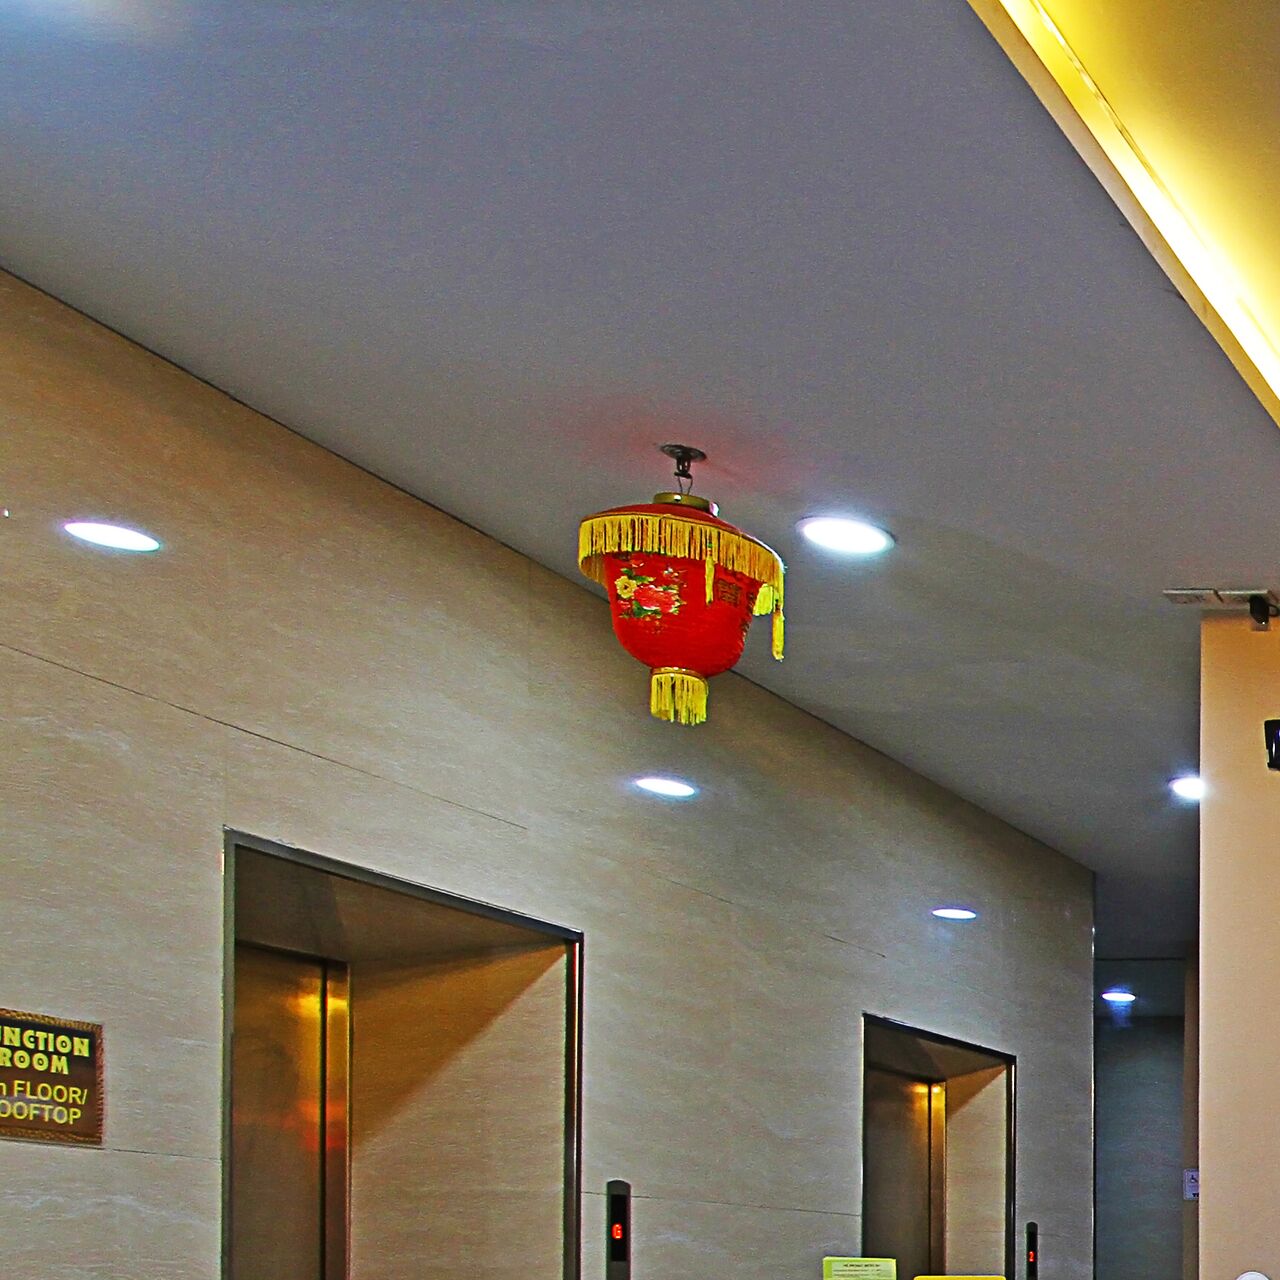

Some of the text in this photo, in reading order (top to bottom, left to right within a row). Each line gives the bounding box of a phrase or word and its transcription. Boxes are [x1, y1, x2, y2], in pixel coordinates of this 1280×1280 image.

[0, 1026, 90, 1057] NCTION
[0, 1047, 69, 1075] ROOM
[14, 1080, 88, 1105] FLOOR/
